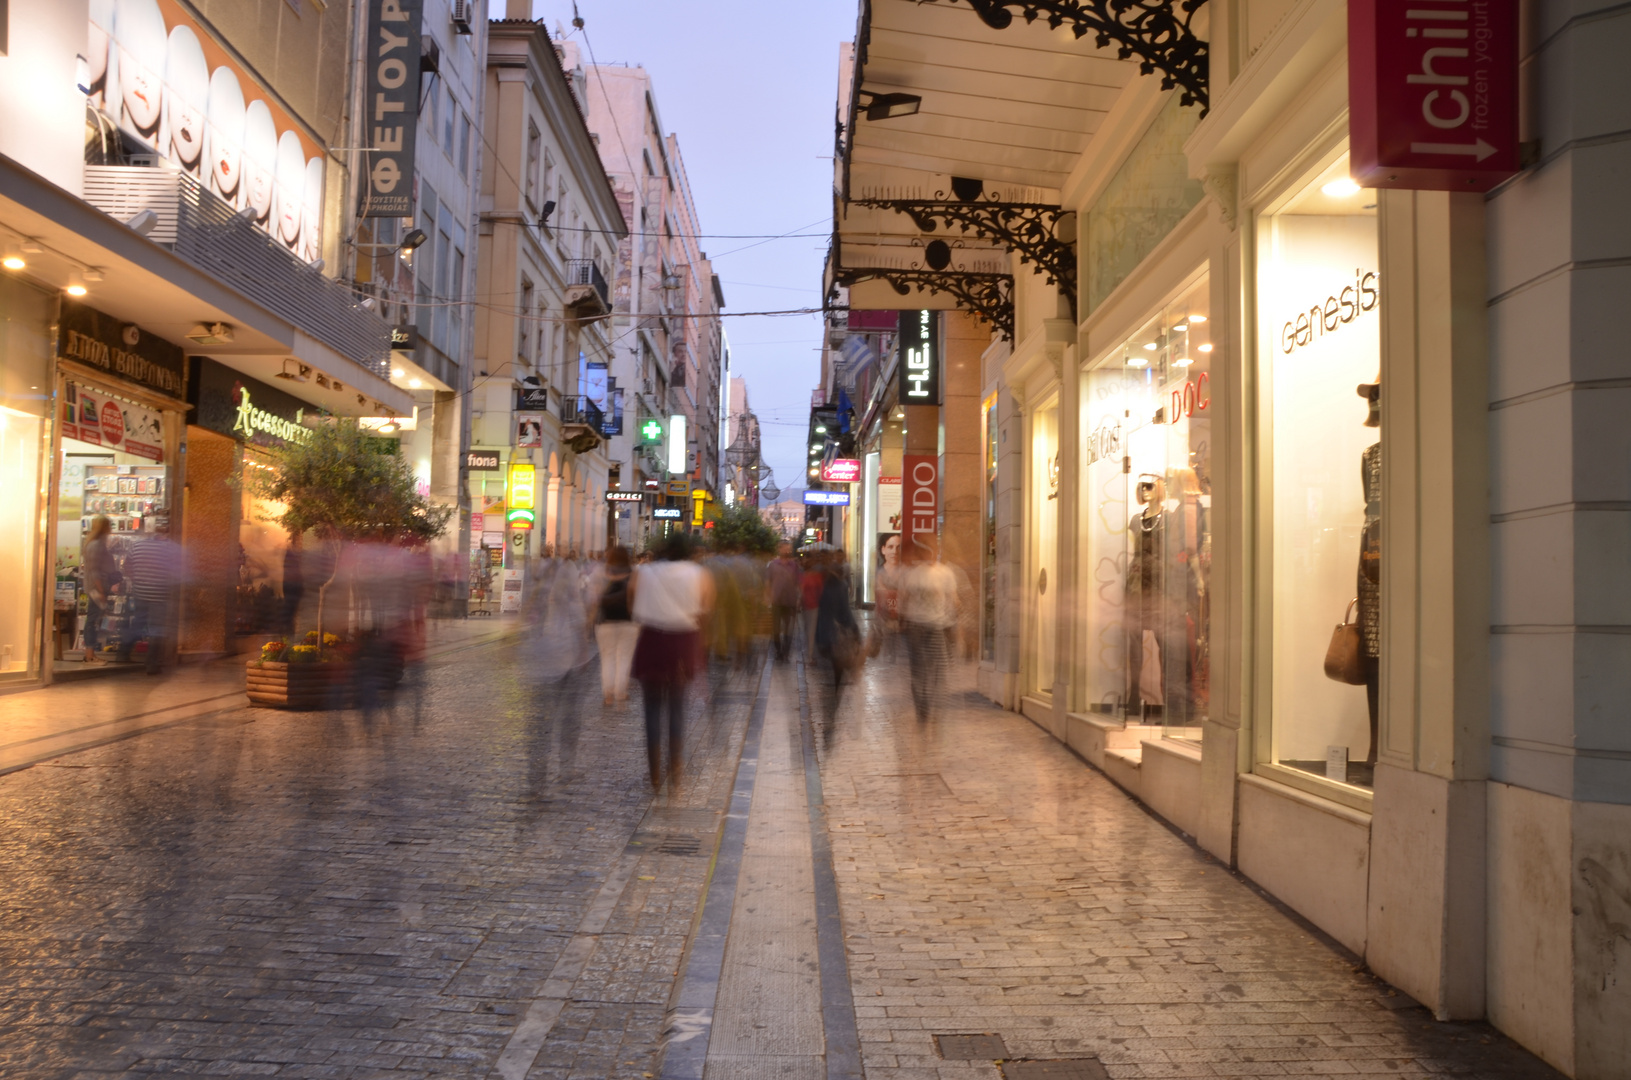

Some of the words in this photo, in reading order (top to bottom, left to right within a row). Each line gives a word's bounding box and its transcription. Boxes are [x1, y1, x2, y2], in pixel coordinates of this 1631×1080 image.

[1471, 1, 1493, 62] yogurt
[1405, 0, 1470, 129] chil
[1471, 71, 1489, 130] frozen
[920, 325, 930, 339] BY
[1281, 268, 1380, 355] Genesis
[1171, 371, 1211, 424] DOC
[467, 454, 498, 467] fiona
